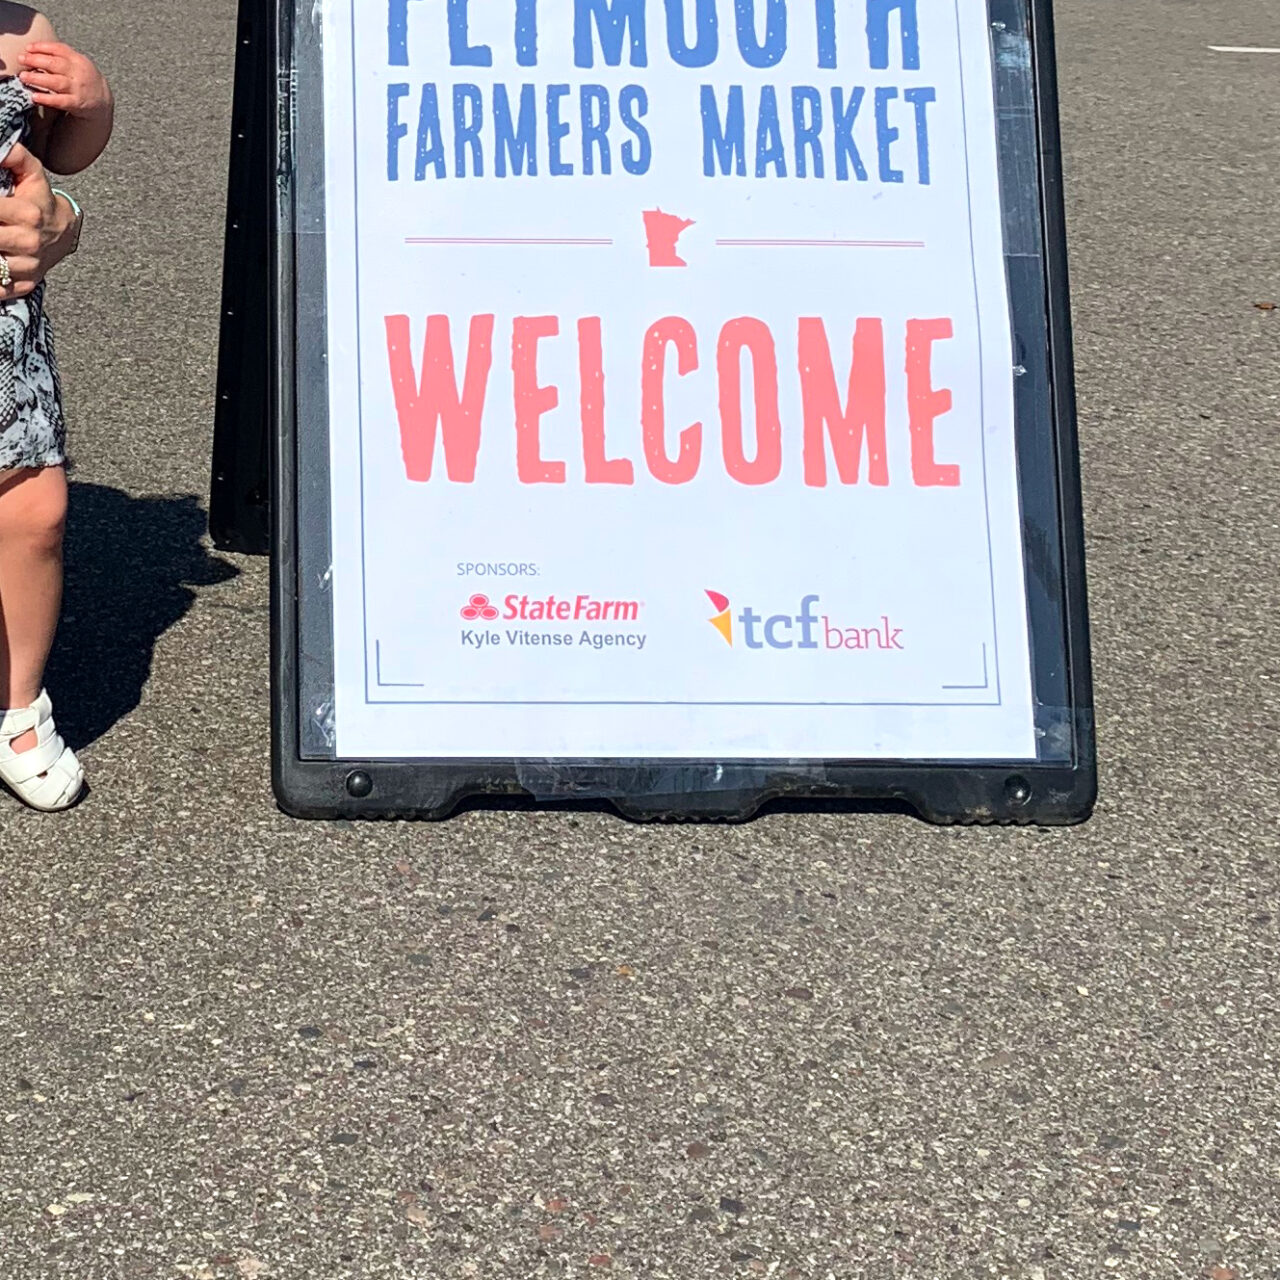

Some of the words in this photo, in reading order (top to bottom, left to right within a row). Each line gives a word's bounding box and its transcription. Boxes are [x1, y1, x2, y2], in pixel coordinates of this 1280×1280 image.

[387, 83, 652, 181] FARMERS
[700, 84, 936, 185] MARKET
[384, 313, 961, 487] WELCOME
[457, 562, 541, 576] SPONSORS:
[461, 630, 500, 649] Kyle
[506, 630, 573, 646] Vitense
[578, 631, 647, 649] Agency
